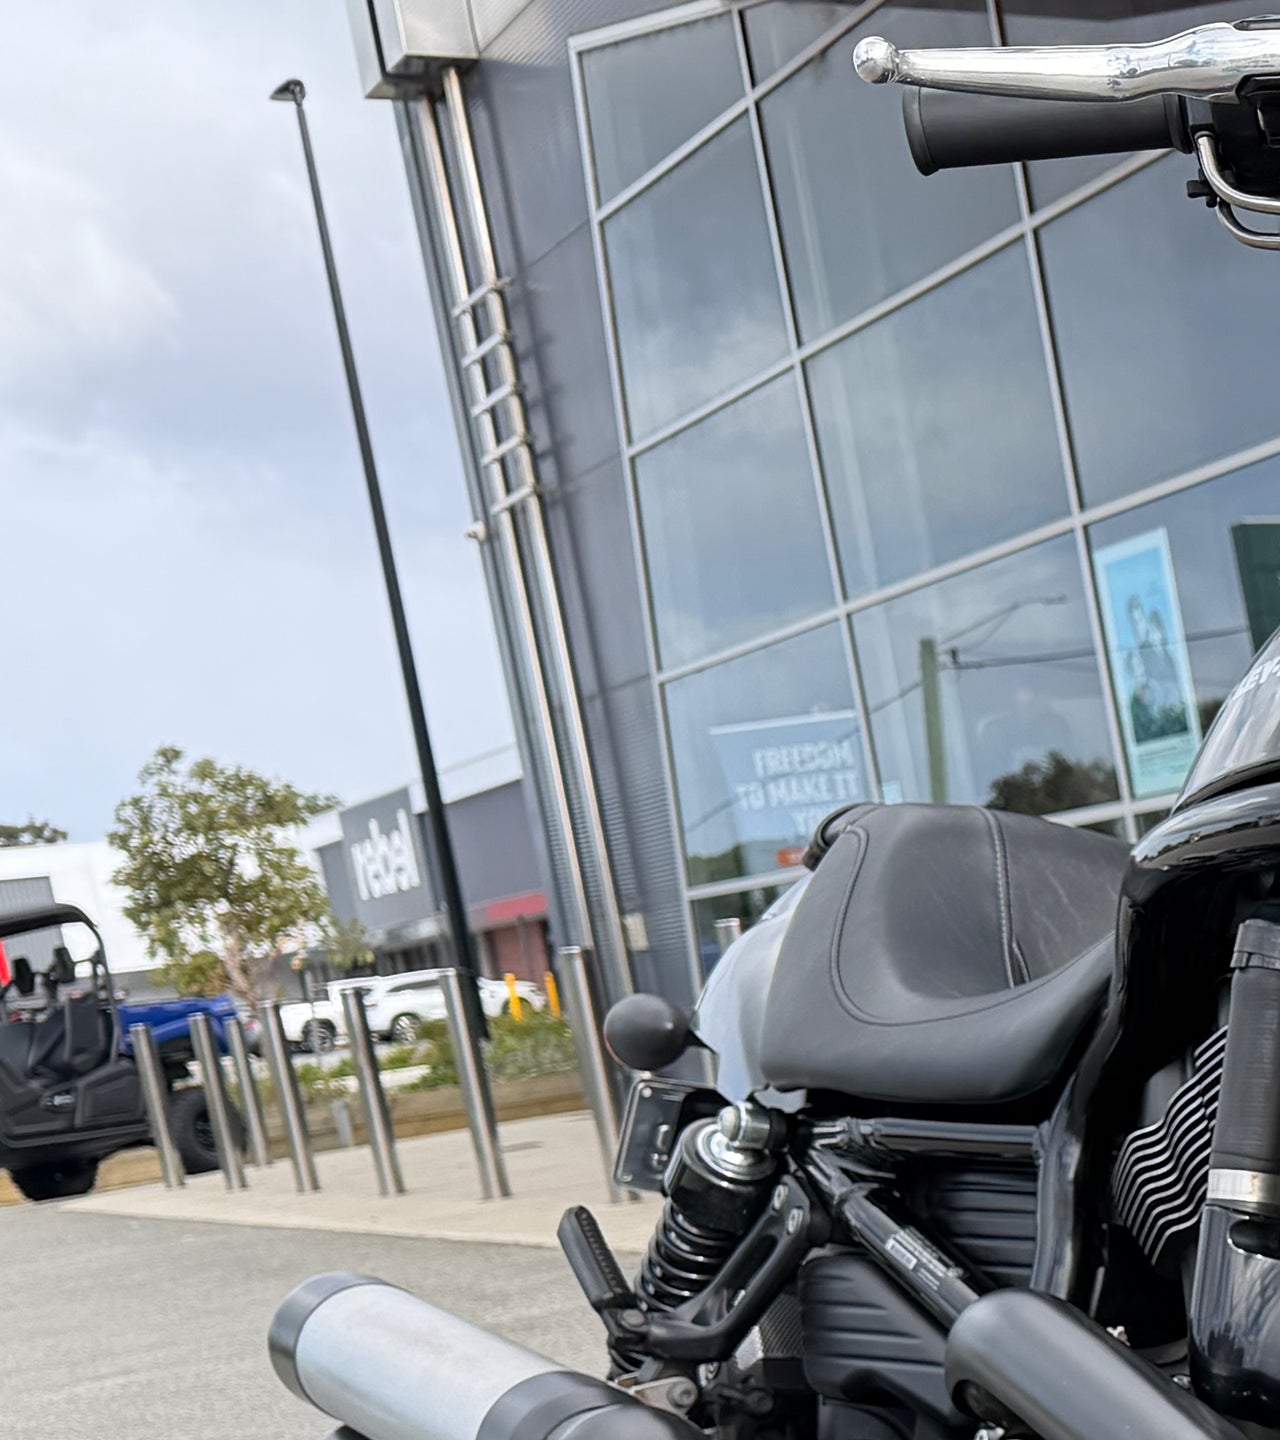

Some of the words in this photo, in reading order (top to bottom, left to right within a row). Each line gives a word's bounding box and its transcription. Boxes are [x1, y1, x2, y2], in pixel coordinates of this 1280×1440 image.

[753, 738, 855, 778] FREEDOM
[736, 781, 765, 810] TO
[769, 773, 832, 807] MAKE
[833, 770, 859, 801] IT
[350, 808, 420, 901] rebel
